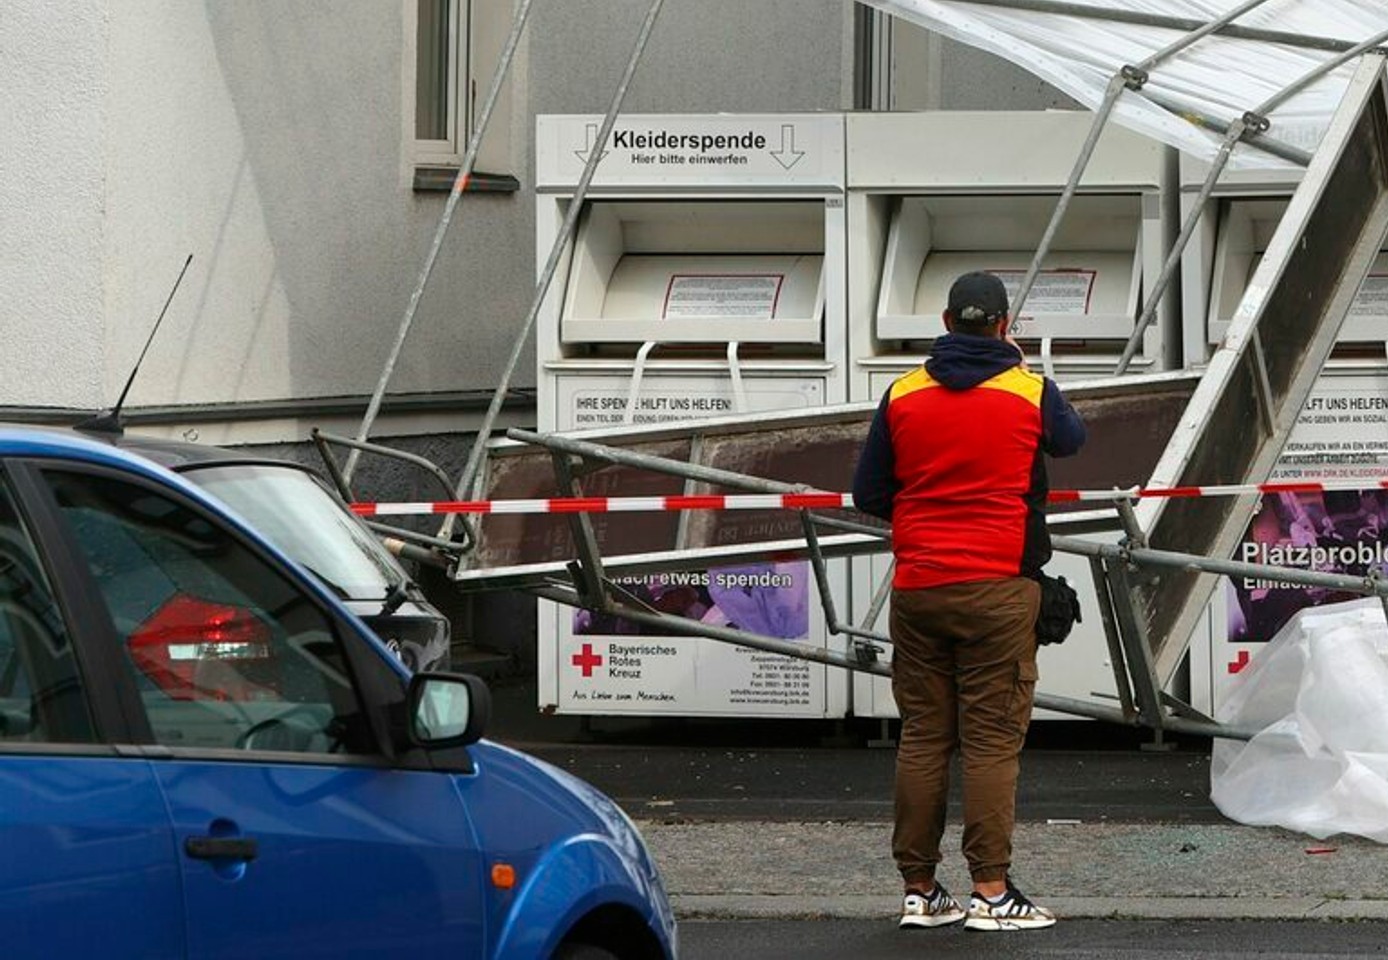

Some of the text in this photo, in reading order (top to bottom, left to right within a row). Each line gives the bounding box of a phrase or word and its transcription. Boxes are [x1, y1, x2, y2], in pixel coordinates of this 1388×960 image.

[614, 130, 766, 152] Kleiderspende
[631, 154, 748, 164] Hier bitte einwerfen
[577, 397, 599, 410] IHRE
[641, 397, 667, 410] HILFT
[670, 397, 689, 410] UNS
[1326, 398, 1347, 410] UNS
[660, 572, 710, 586] etwas
[716, 570, 792, 588] spenden
[609, 643, 677, 656] Bayerisches
[609, 656, 641, 666] Rotes
[609, 668, 641, 678] Kreuz
